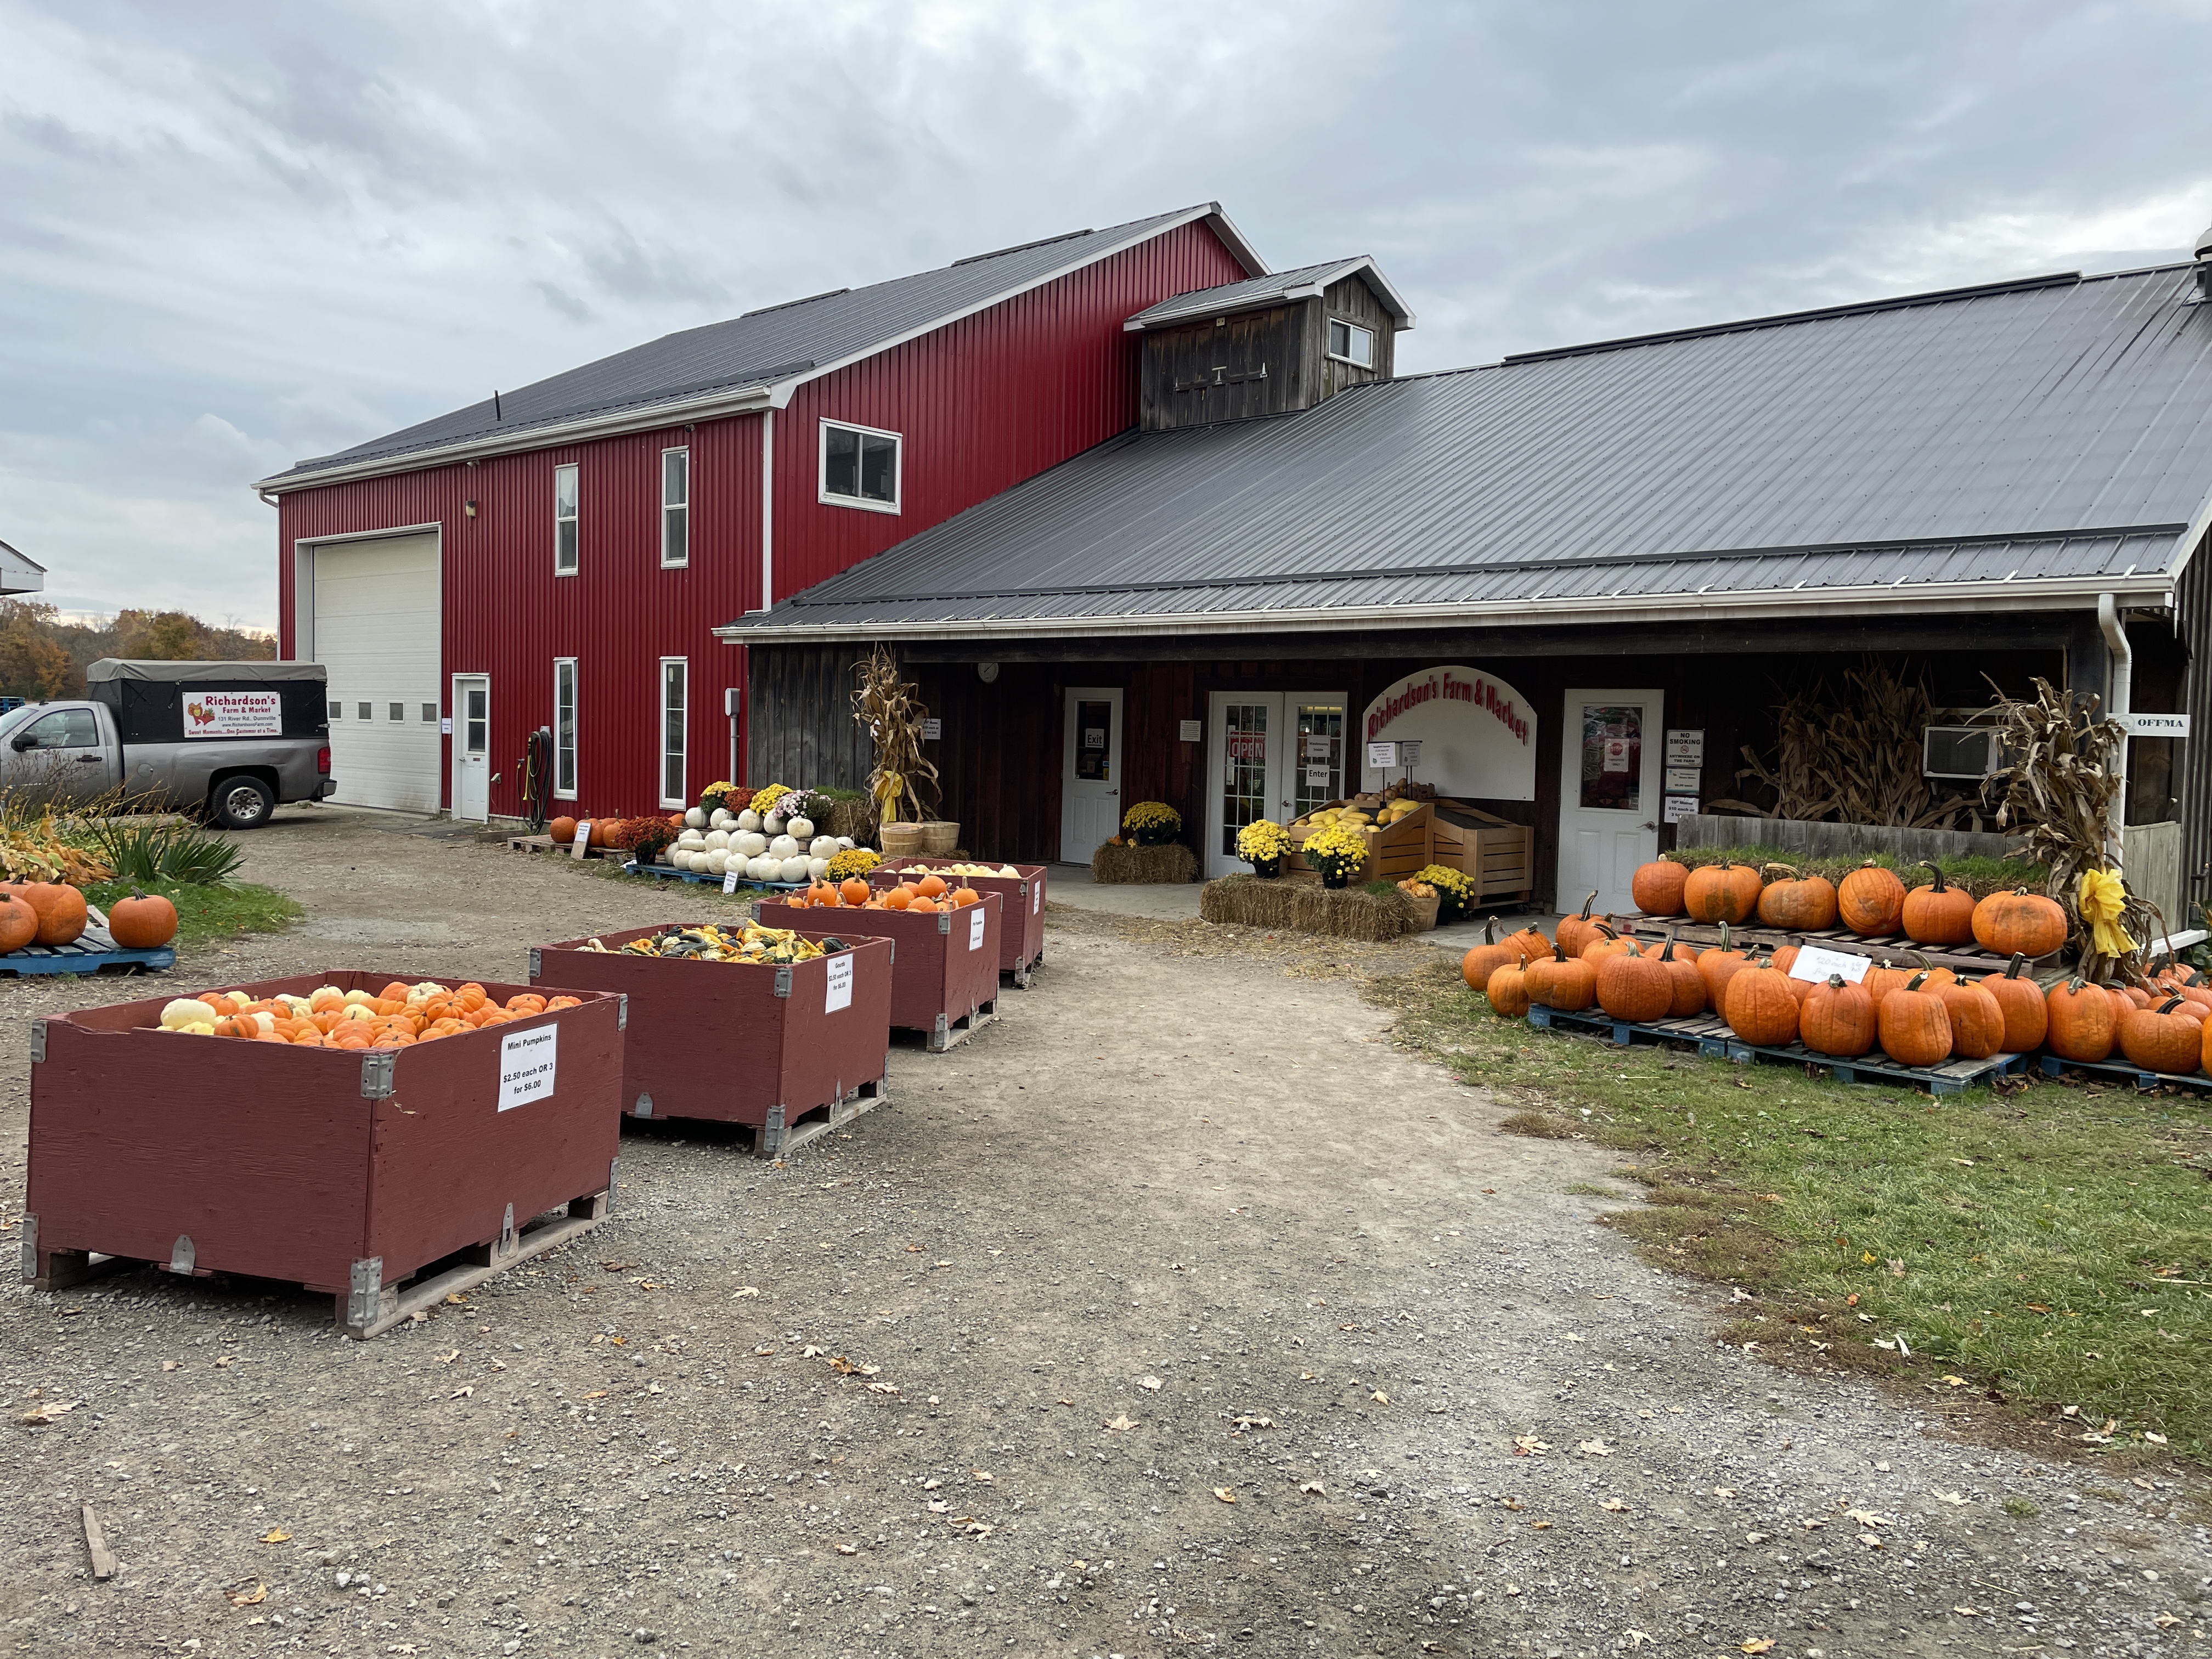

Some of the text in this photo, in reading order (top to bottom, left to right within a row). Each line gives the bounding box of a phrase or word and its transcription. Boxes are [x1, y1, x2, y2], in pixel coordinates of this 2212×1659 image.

[205, 696, 276, 706] Richardson's
[1368, 673, 1527, 746] Richardson's Farm & Market
[2138, 719, 2184, 727] OFFMA
[1087, 735, 1102, 744] Exit
[1231, 742, 1263, 757] OPEN
[1309, 770, 1328, 778] Enter
[507, 1034, 551, 1051] Mini Pumpkins
[503, 1071, 521, 1084] $2.50
[522, 1067, 537, 1077] each
[539, 1064, 548, 1073] OR
[514, 1080, 541, 1094] for $6.00
